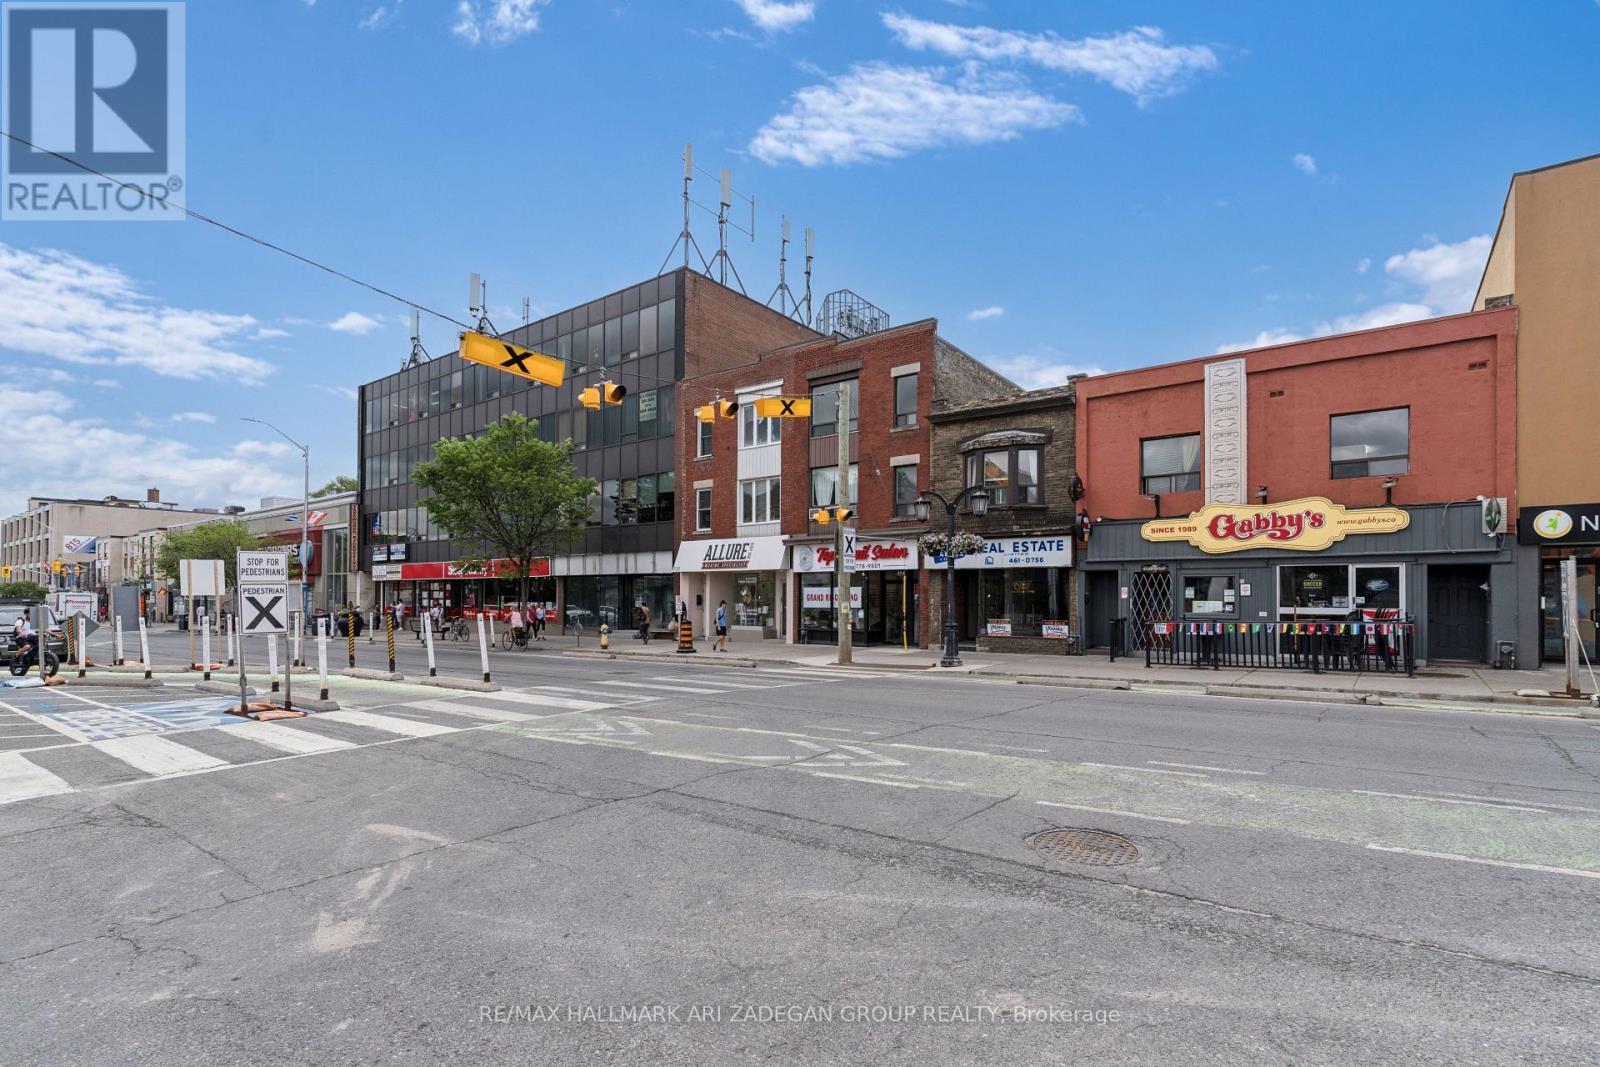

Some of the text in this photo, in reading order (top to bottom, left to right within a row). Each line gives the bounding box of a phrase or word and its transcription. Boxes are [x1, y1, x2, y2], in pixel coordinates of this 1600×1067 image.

[1206, 509, 1325, 542] Gabby's
[1337, 516, 1396, 525] www.gabbys.ca
[703, 543, 749, 561] ALLURE
[871, 543, 909, 561] Salon
[982, 540, 1064, 553] EAL ESTATE
[247, 558, 279, 566] STOP FOR
[241, 568, 285, 576] PEDESTRIANS
[243, 587, 285, 595] PEDESTRIAN
